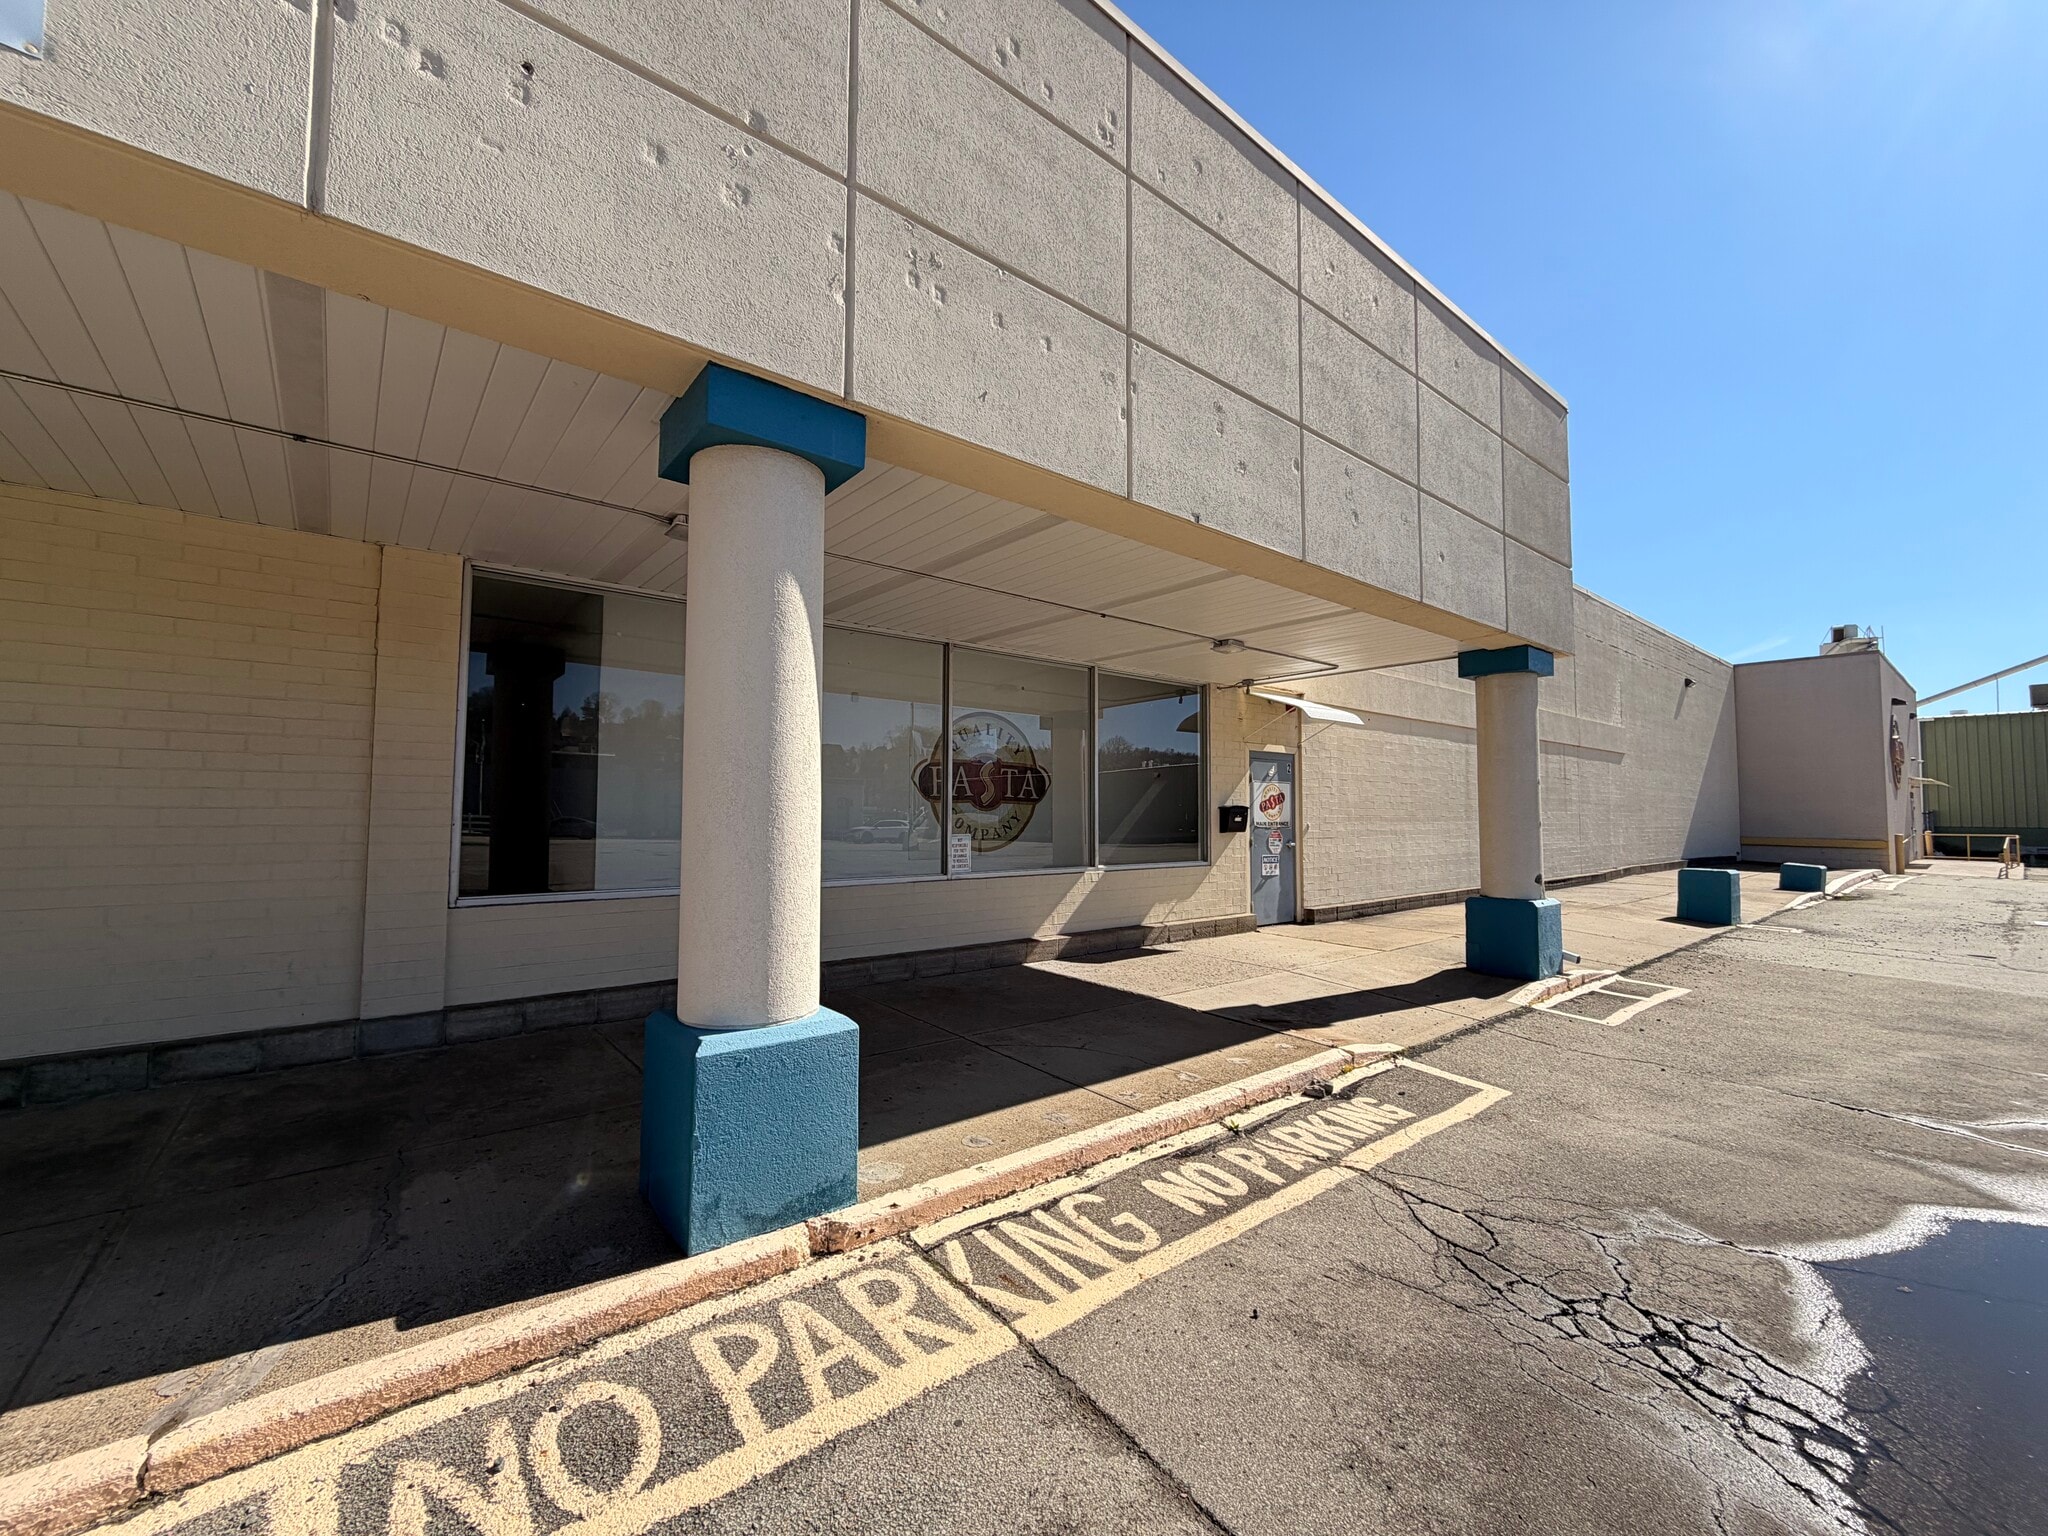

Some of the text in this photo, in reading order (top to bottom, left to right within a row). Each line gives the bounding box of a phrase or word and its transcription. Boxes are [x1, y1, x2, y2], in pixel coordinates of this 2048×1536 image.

[1261, 795, 1284, 811] PASTA
[1142, 1096, 1417, 1216] NO PARKING
[385, 1192, 1161, 1536] NO PARKING
